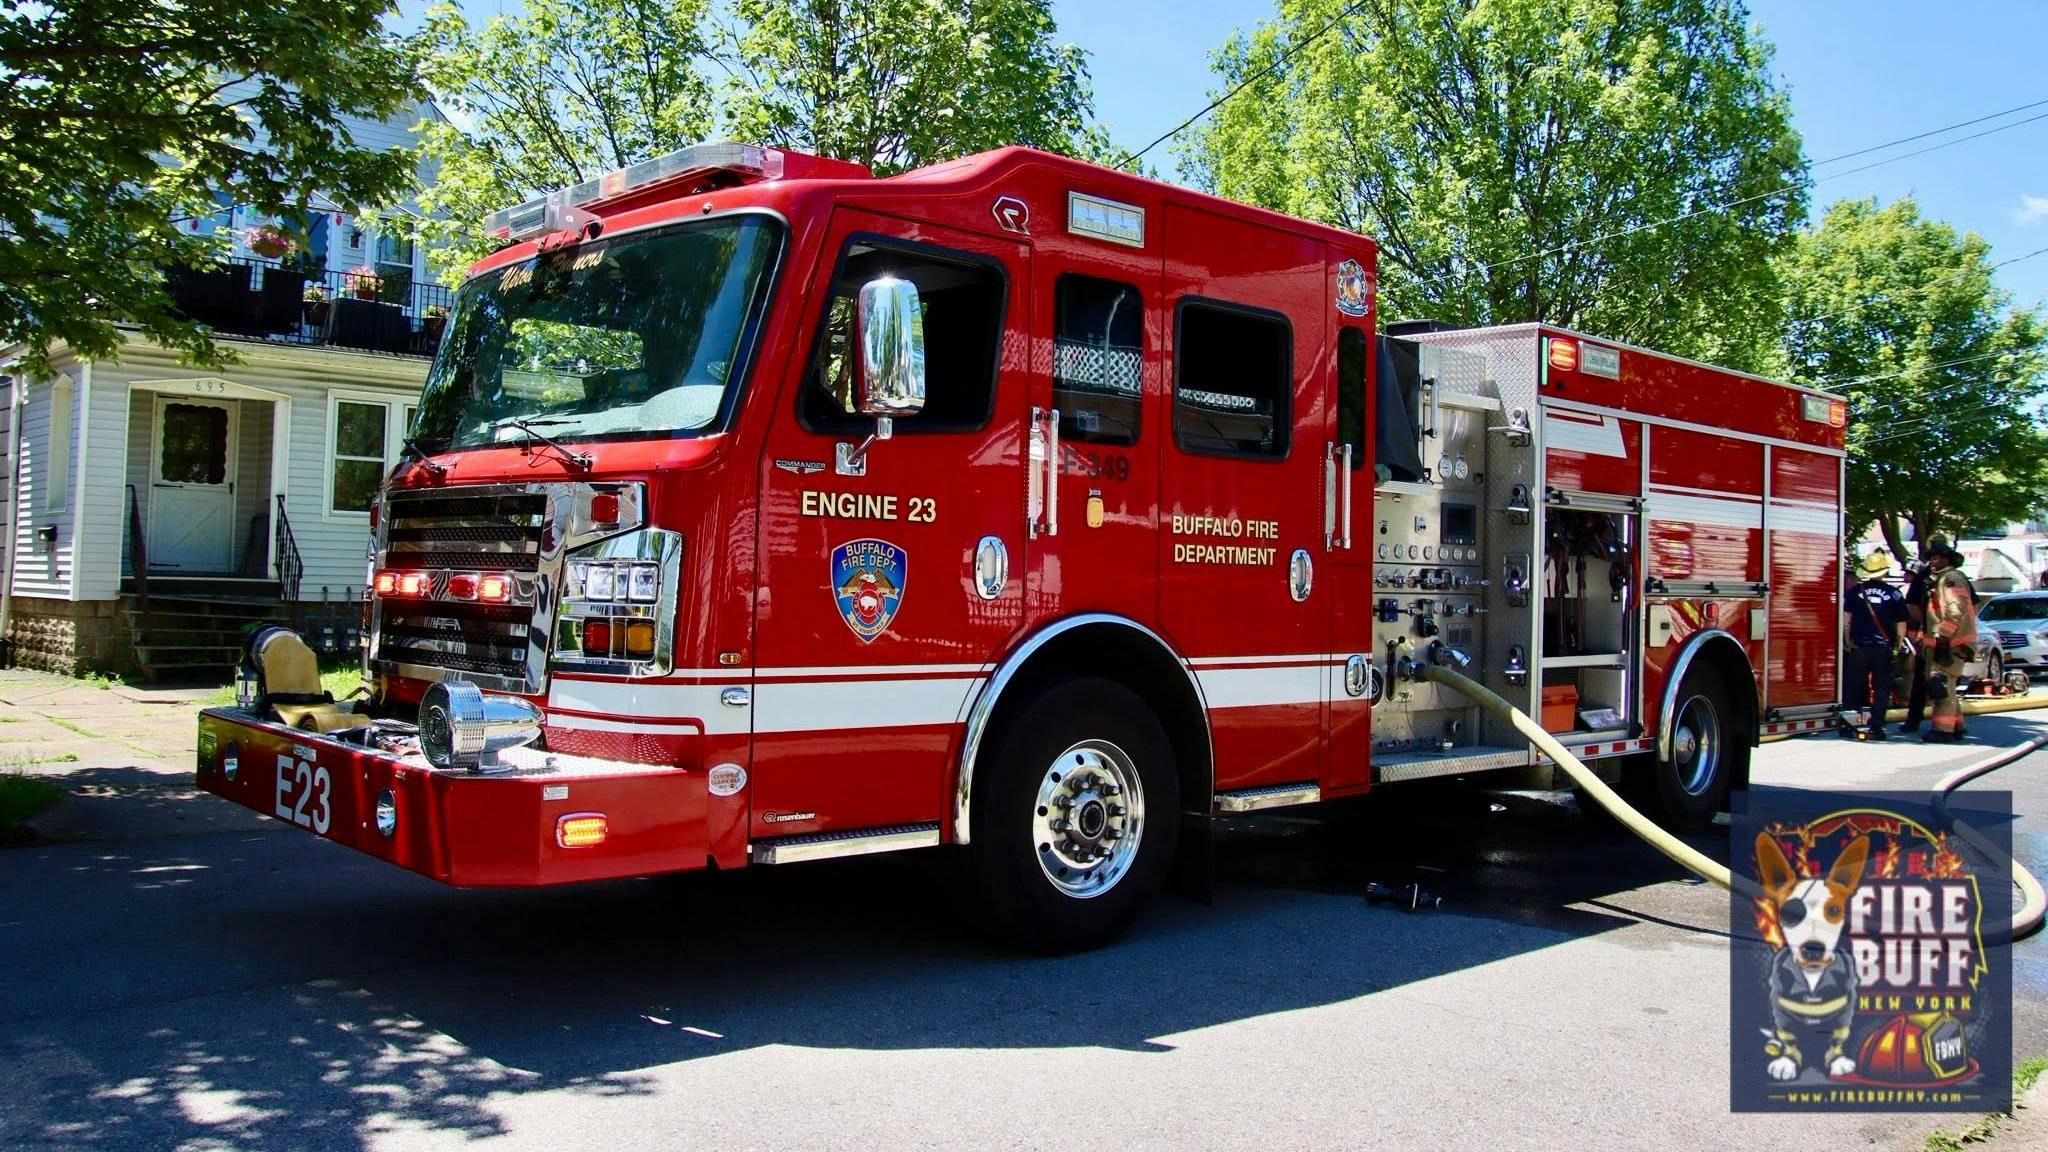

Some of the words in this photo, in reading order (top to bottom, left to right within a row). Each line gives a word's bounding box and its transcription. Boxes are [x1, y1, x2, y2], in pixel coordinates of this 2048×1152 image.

[196, 381, 225, 393] 695
[775, 460, 826, 469] COMMANDER
[802, 491, 898, 520] ENGINE
[908, 497, 937, 522] 23
[1172, 515, 1243, 537] BUFFALO
[1246, 520, 1279, 539] FIRE
[845, 543, 895, 559] BUFFALO
[1174, 544, 1277, 566] DEPARTMENT
[841, 555, 866, 571] FIRE
[869, 555, 897, 573] DEPT.
[275, 753, 331, 835] E23
[776, 812, 816, 823] rosenbauer
